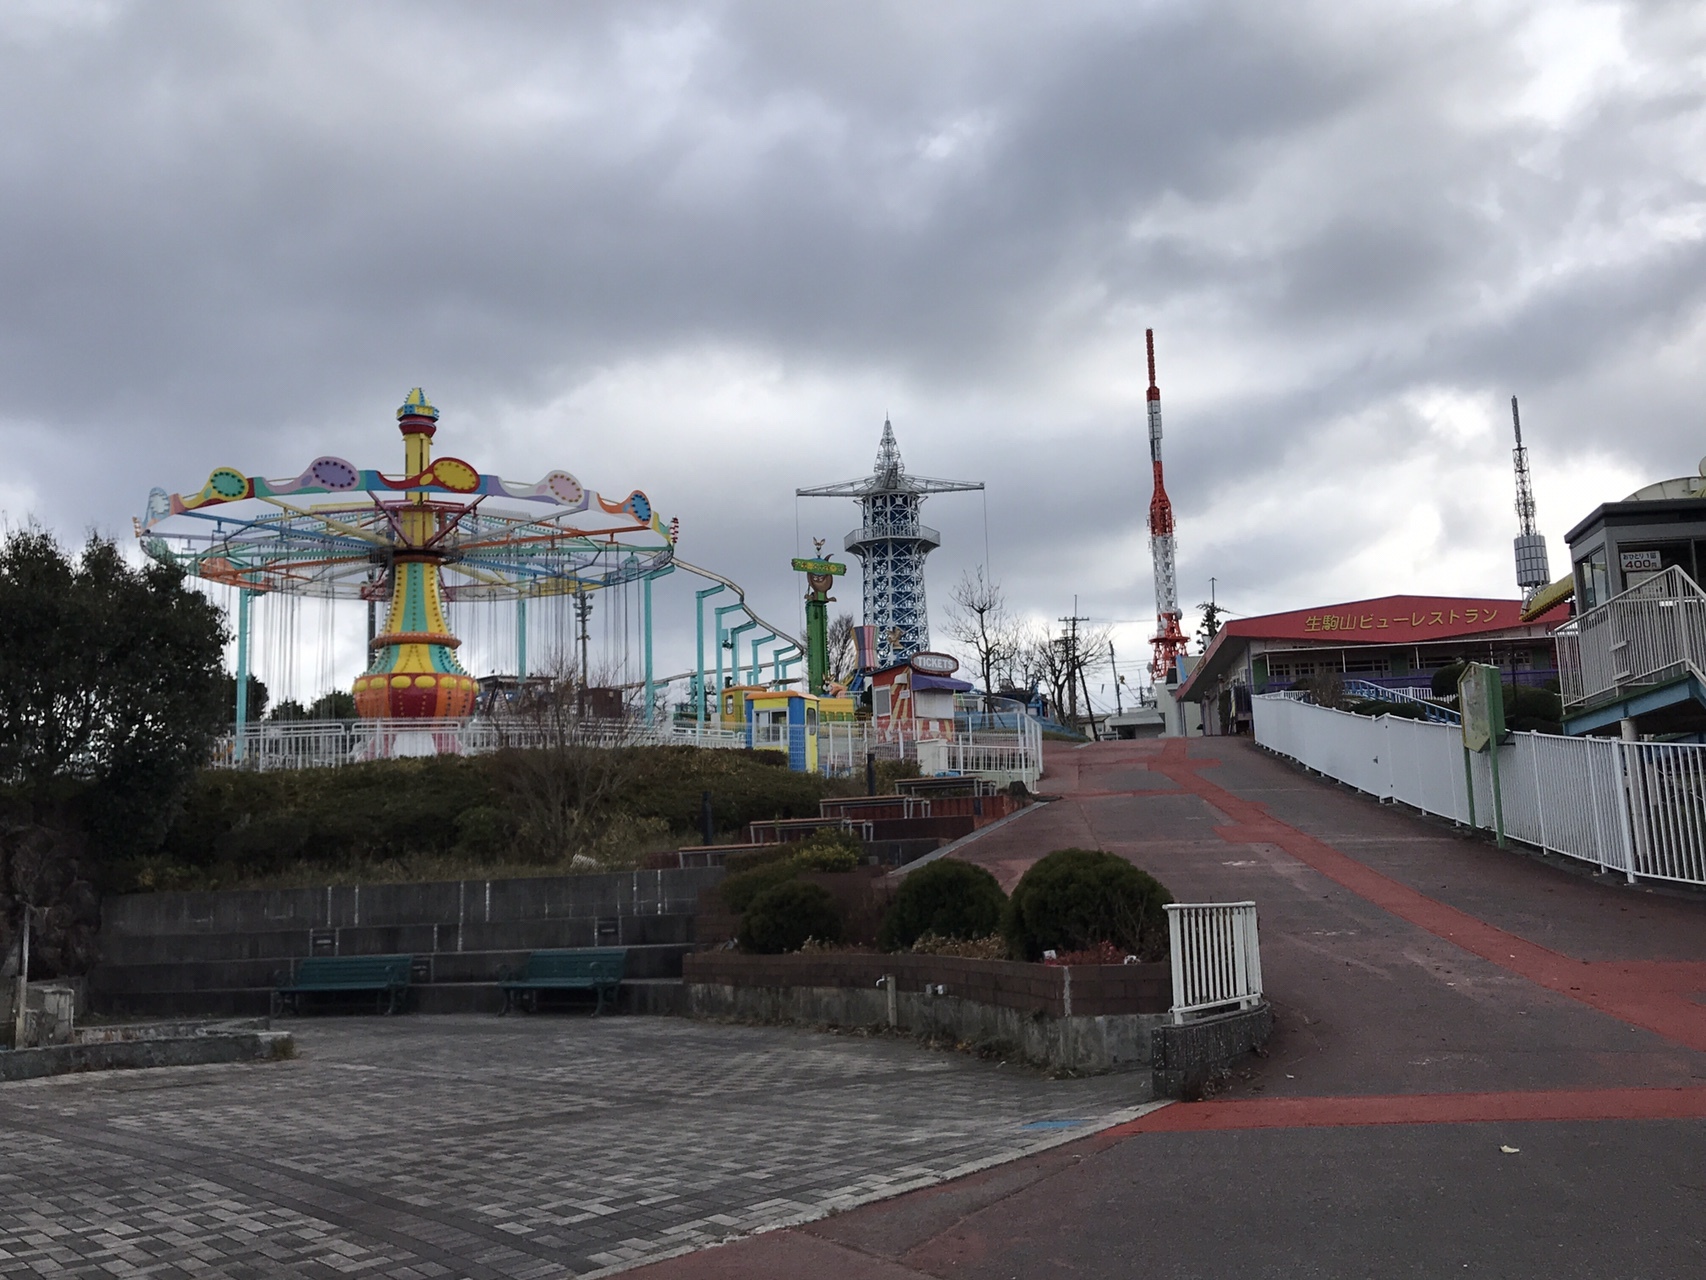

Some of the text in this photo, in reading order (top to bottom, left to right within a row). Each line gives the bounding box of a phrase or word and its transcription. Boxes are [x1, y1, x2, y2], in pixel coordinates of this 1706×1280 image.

[1625, 560, 1657, 569] 400円
[1304, 609, 1498, 632] 生駒山ビューレストラン
[918, 657, 954, 669] TICKETS
